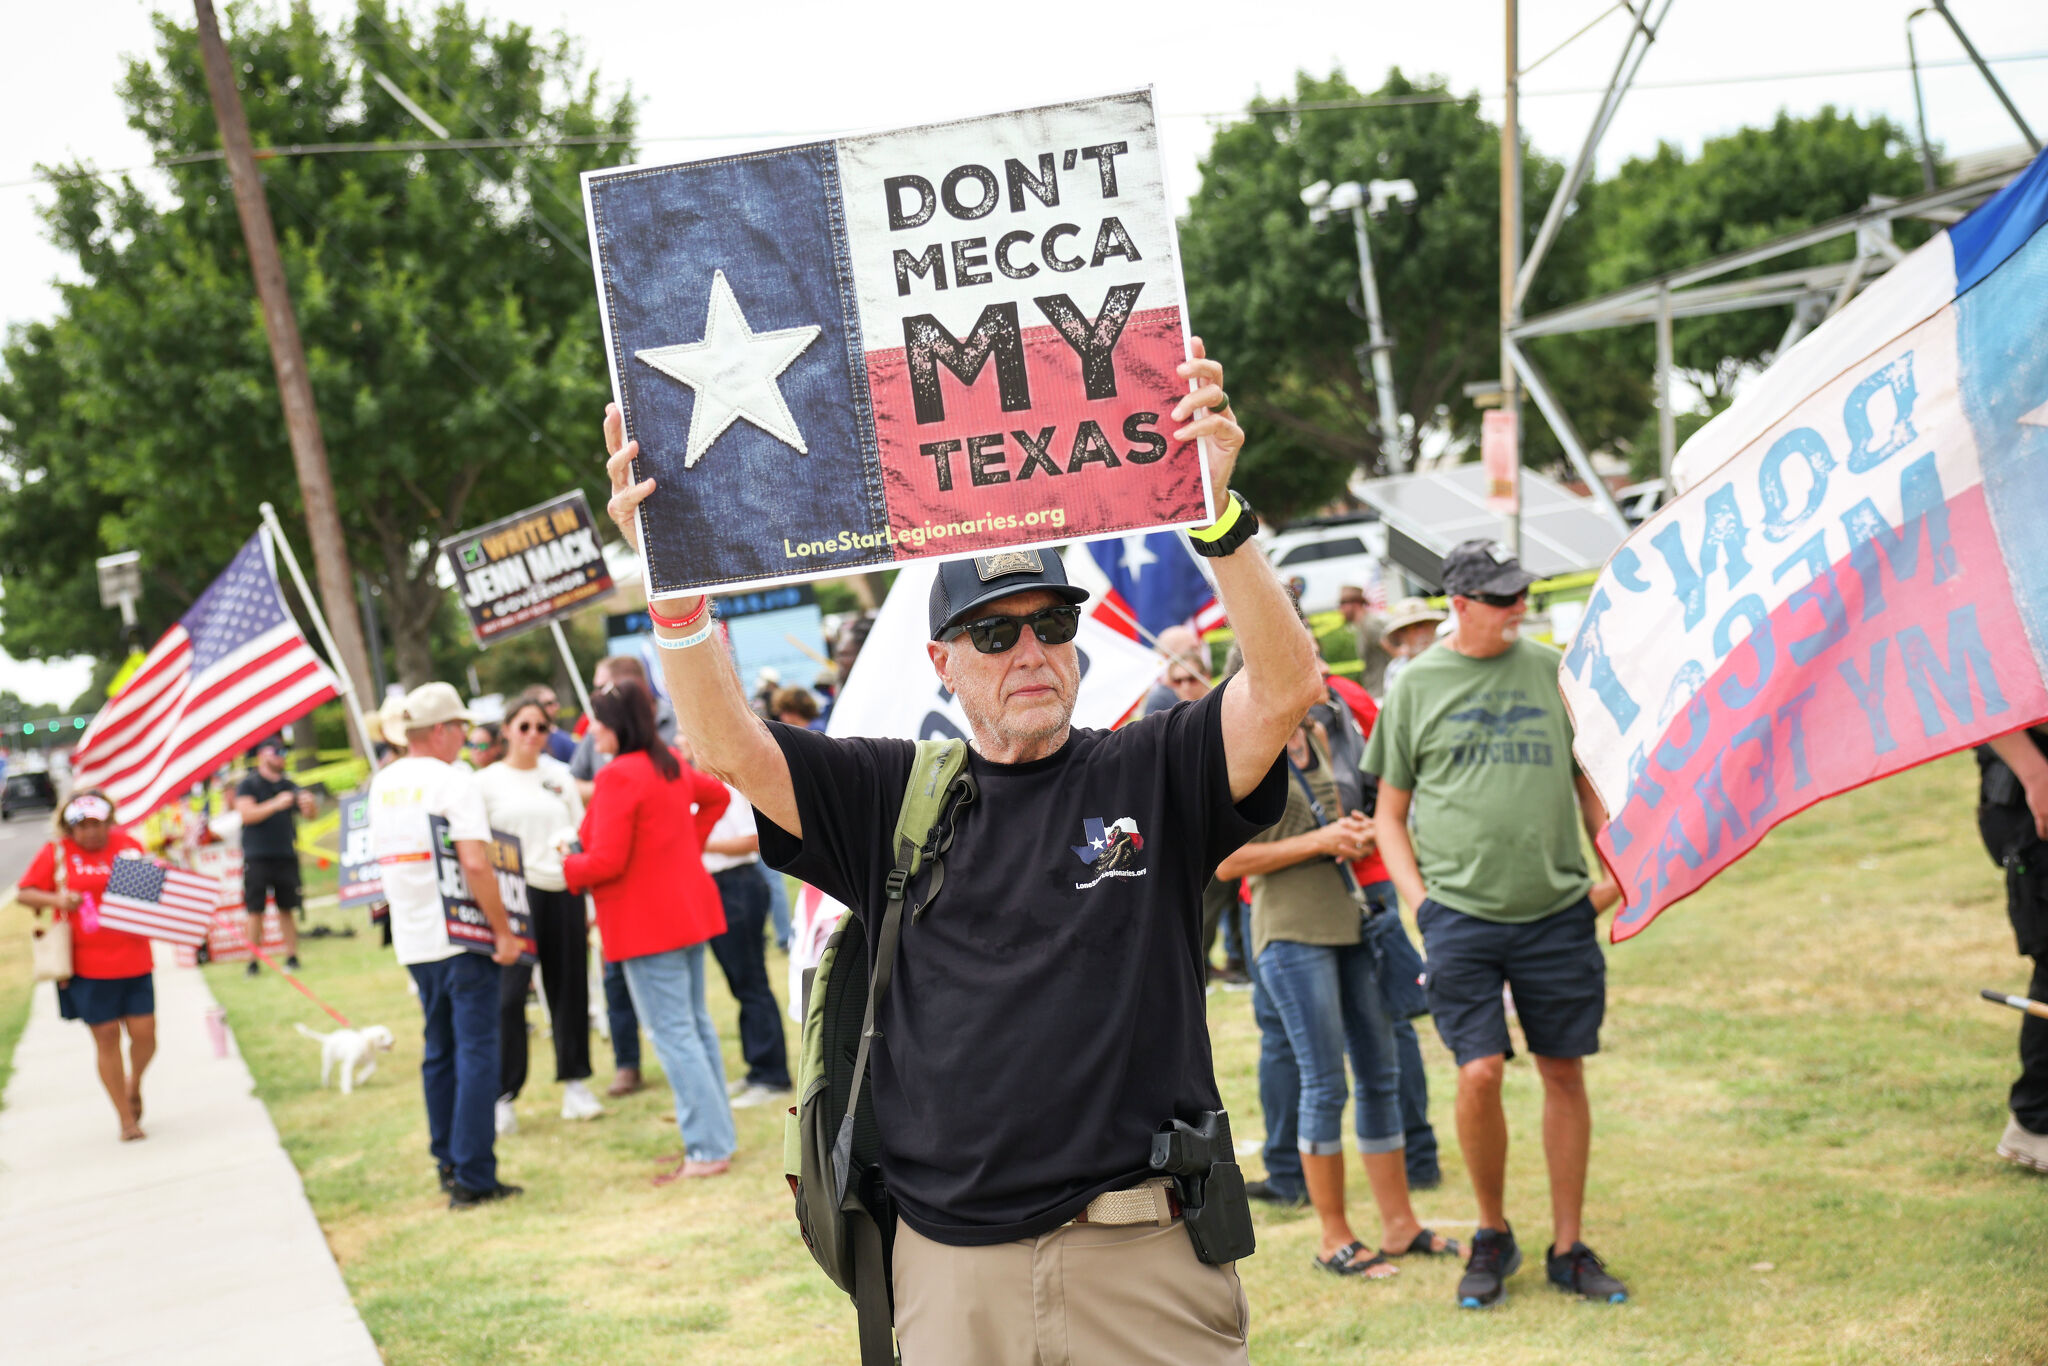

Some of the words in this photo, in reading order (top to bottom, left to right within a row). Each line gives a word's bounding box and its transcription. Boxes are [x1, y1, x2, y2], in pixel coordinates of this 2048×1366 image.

[884, 141, 1129, 231] DON'T
[893, 217, 1143, 295] MECCA
[903, 282, 1144, 425] MY
[920, 412, 1168, 491] TEXAS
[464, 555, 531, 608] JENN
[524, 528, 600, 583] MACK
[784, 507, 1066, 559] LoneStarLegionaries.org
